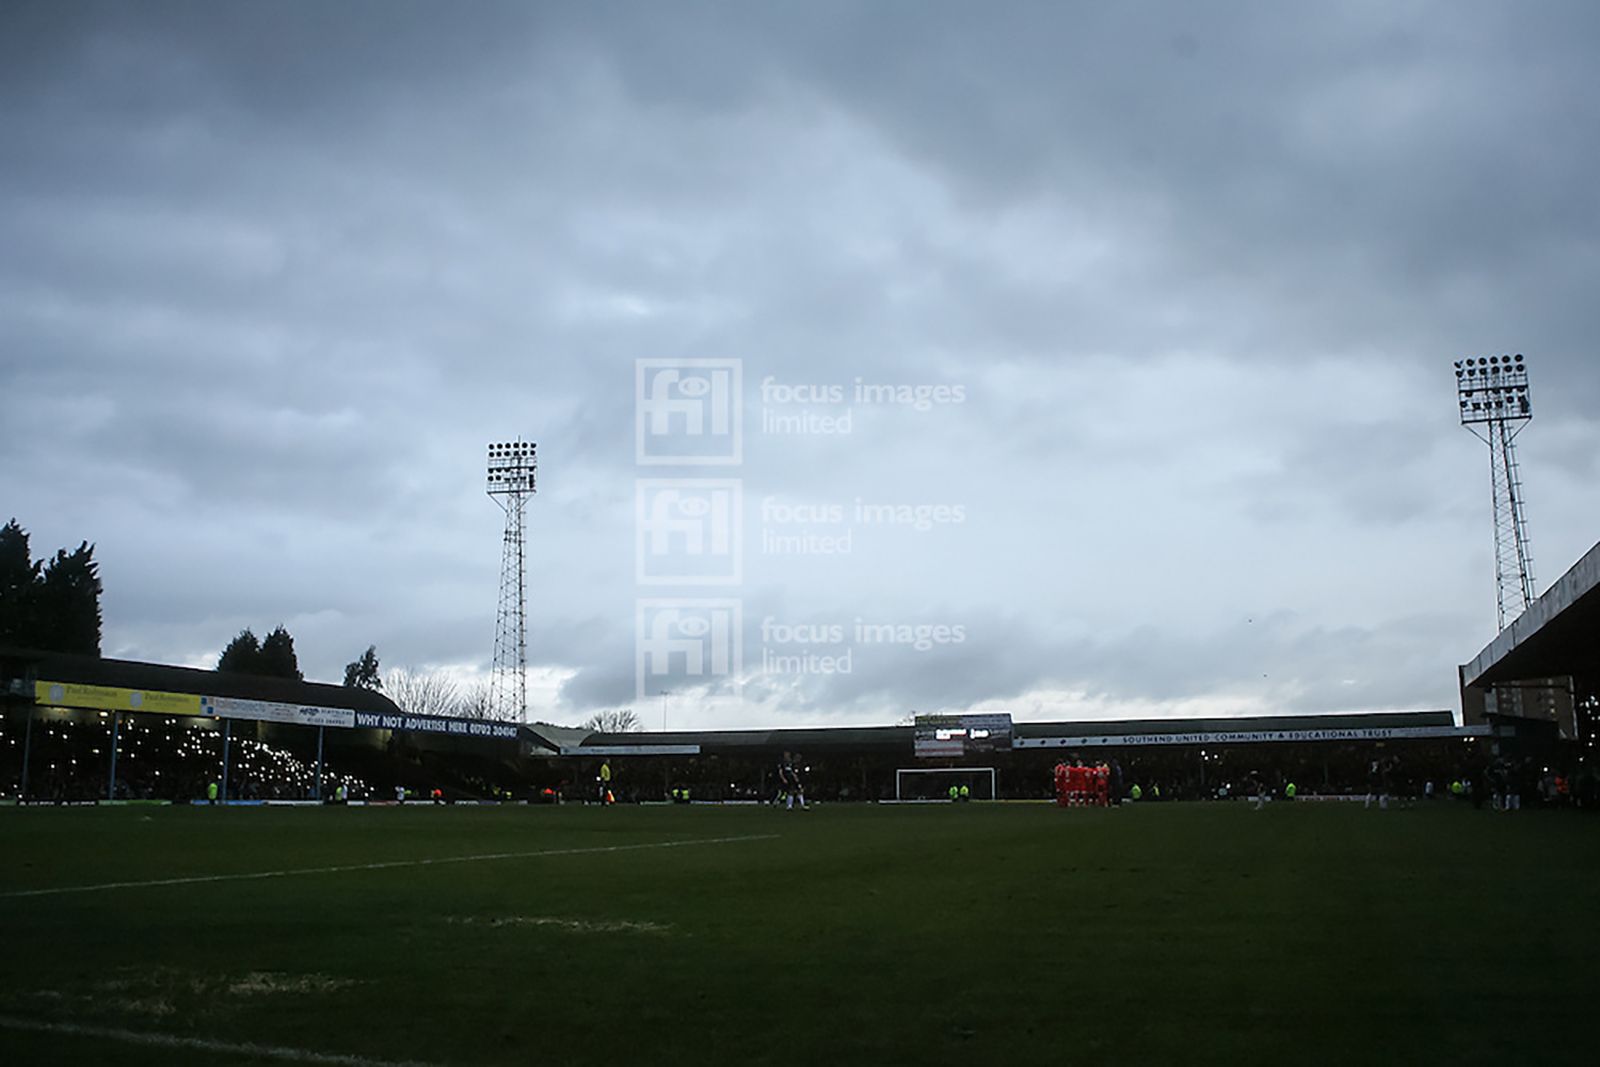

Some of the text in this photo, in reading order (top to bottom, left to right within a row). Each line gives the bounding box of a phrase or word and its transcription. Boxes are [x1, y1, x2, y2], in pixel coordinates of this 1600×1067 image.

[357, 713, 380, 726] WHY
[383, 716, 402, 728] NOT
[405, 718, 447, 732] ADVERTISE
[449, 721, 467, 733] HERE
[1123, 736, 1172, 744] SOUTHEND
[1176, 734, 1210, 742] UNITED
[1215, 732, 1273, 742] COMMUNITY
[1289, 730, 1358, 740] EDUCATIONAL
[1363, 729, 1392, 738] TRUST
